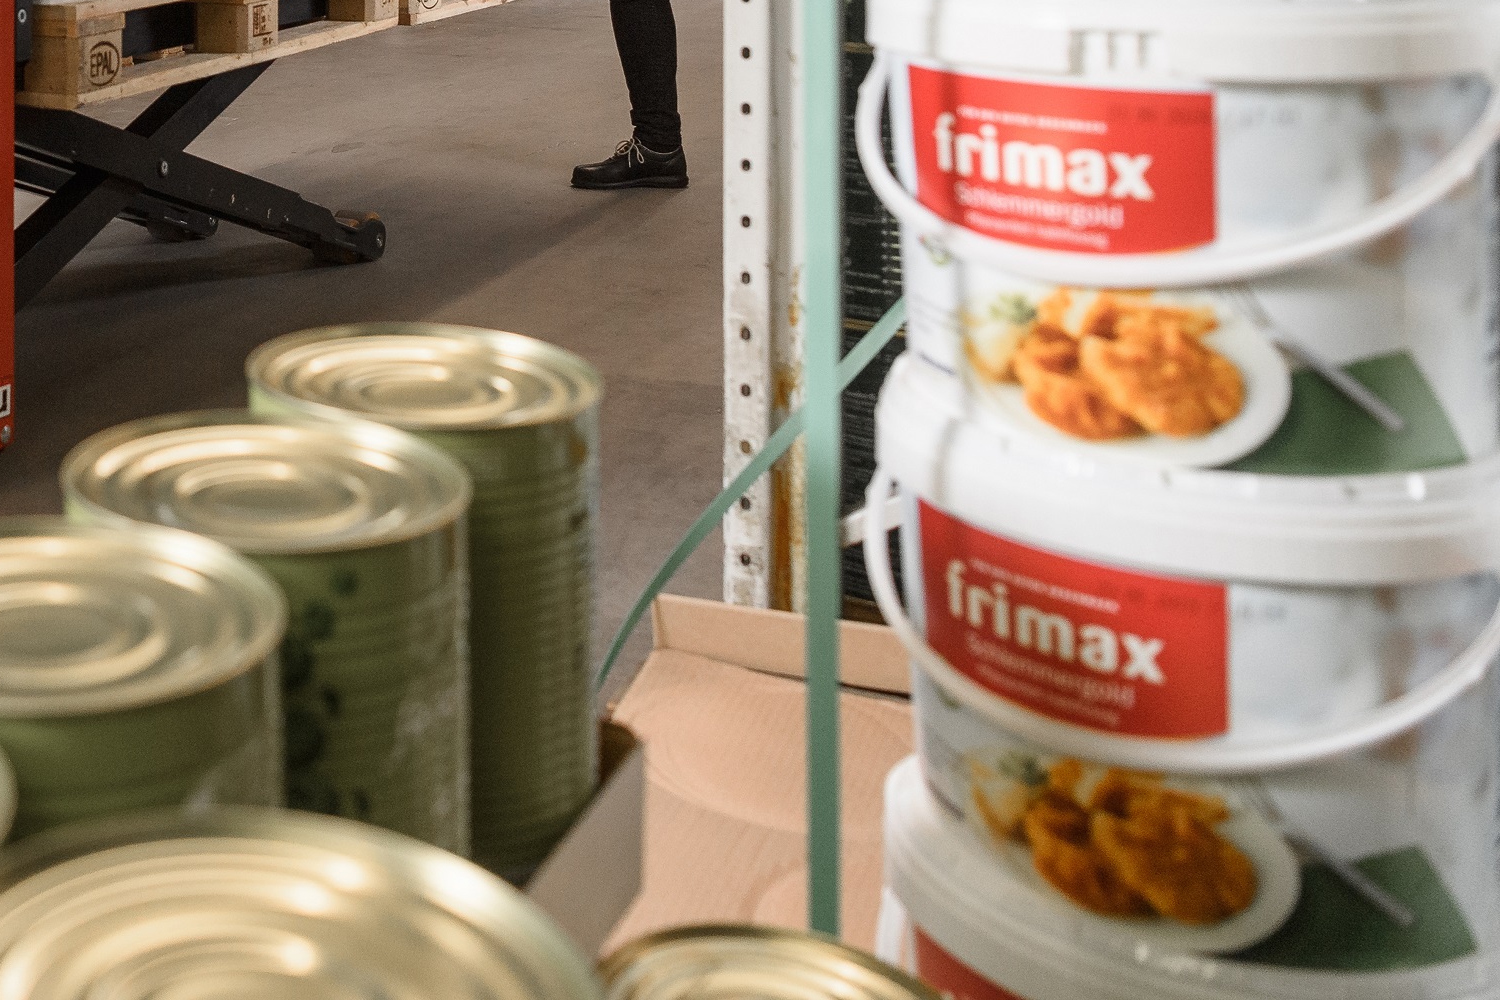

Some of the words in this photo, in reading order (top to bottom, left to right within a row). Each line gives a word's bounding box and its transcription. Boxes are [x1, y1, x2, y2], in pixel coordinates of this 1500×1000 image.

[90, 53, 115, 78] EPAL
[933, 112, 1155, 202] frimax
[946, 559, 1167, 686] frimax
